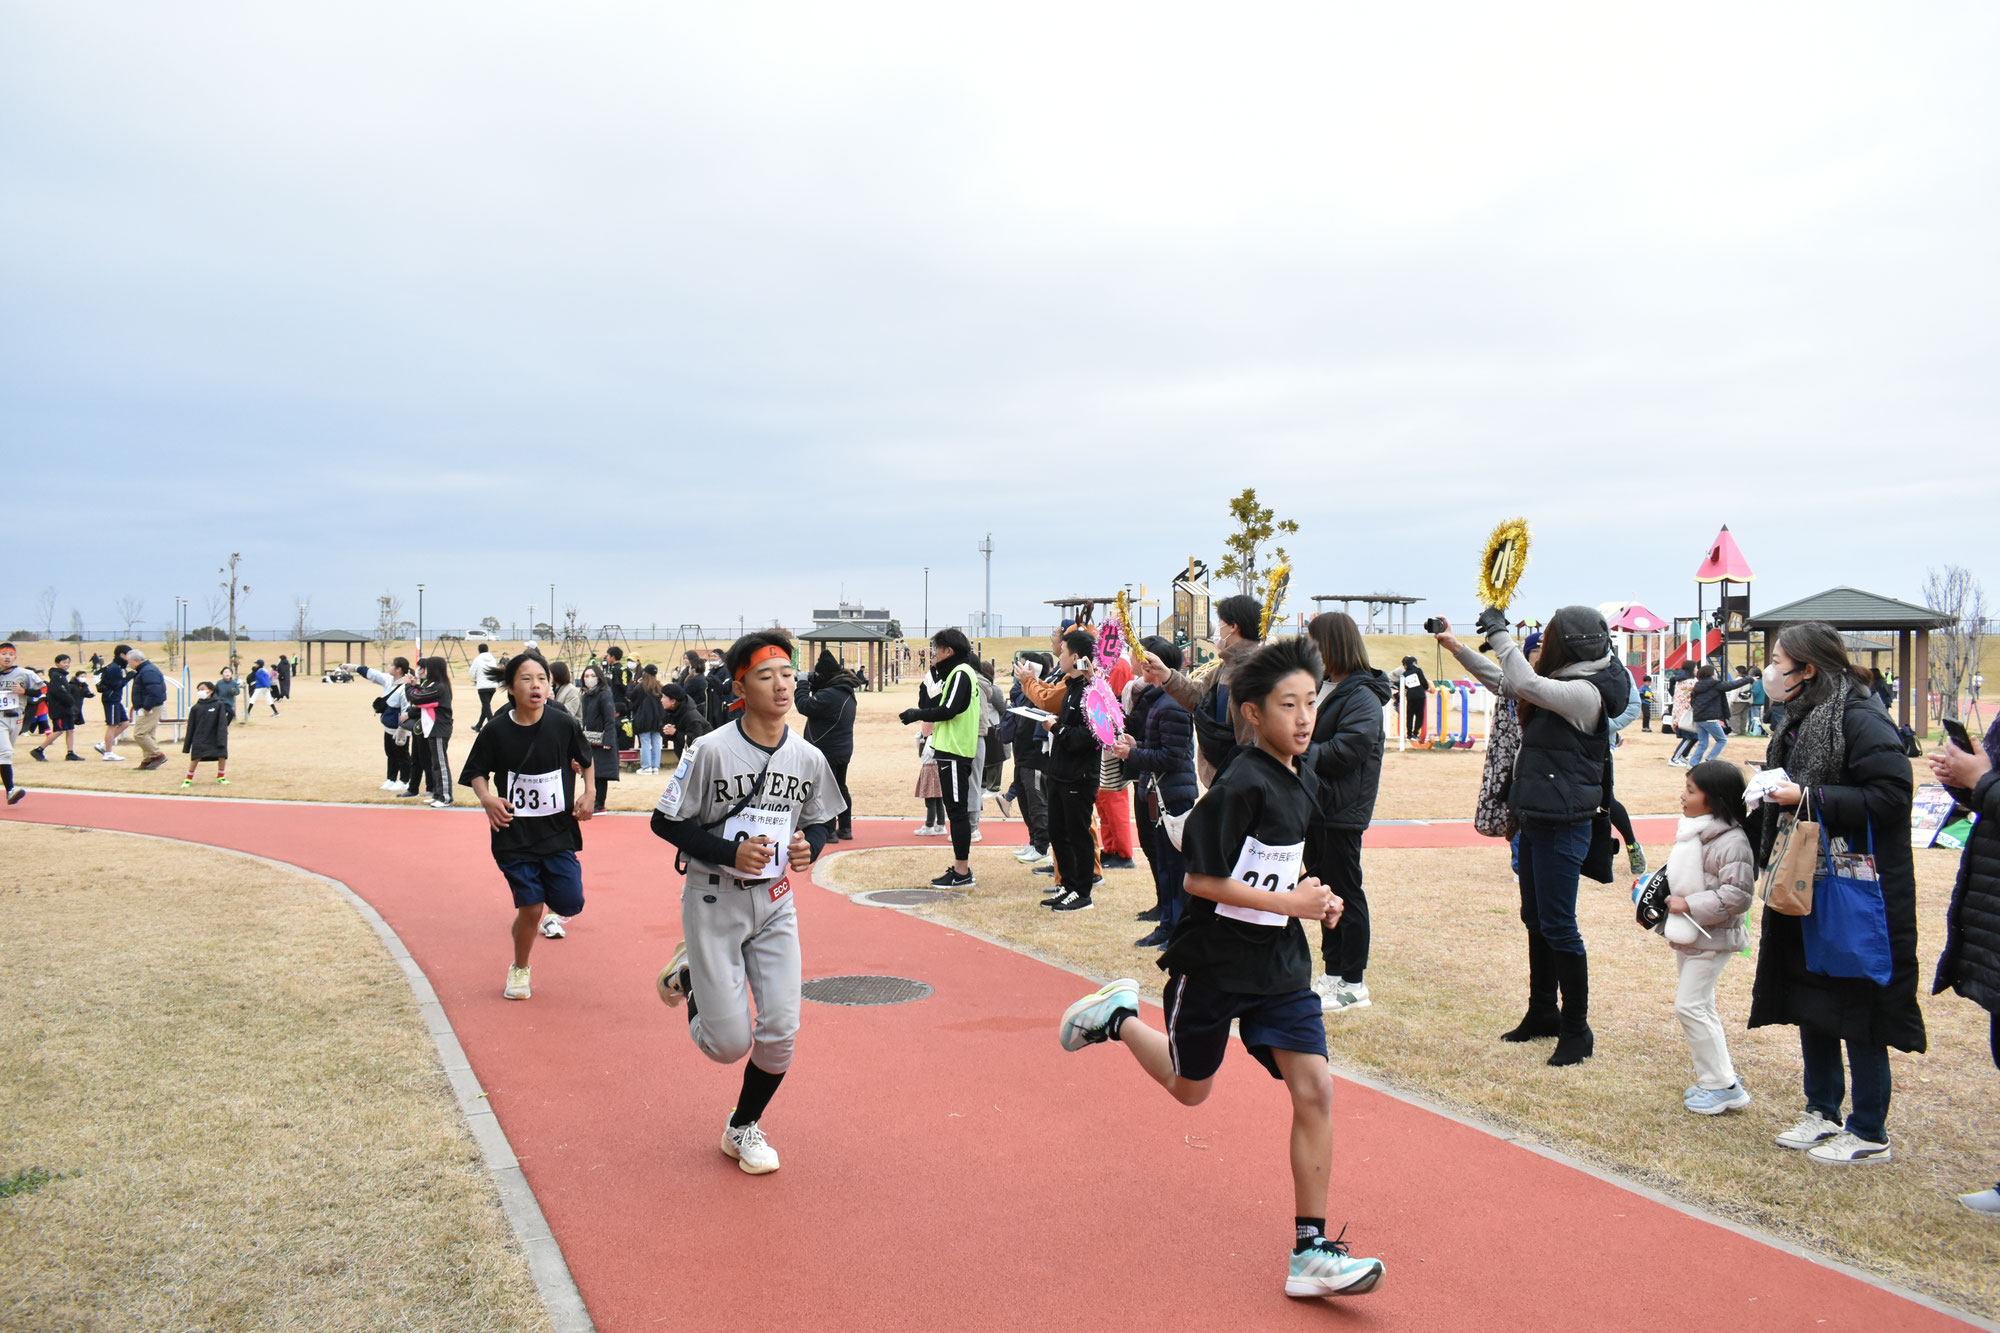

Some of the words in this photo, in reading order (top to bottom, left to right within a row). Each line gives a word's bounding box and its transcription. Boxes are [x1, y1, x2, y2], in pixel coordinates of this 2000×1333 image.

[0, 697, 16, 707] 9-1
[515, 787, 557, 810] 33-1
[773, 881, 789, 898] ECC
[1642, 874, 1664, 905] POLICE
